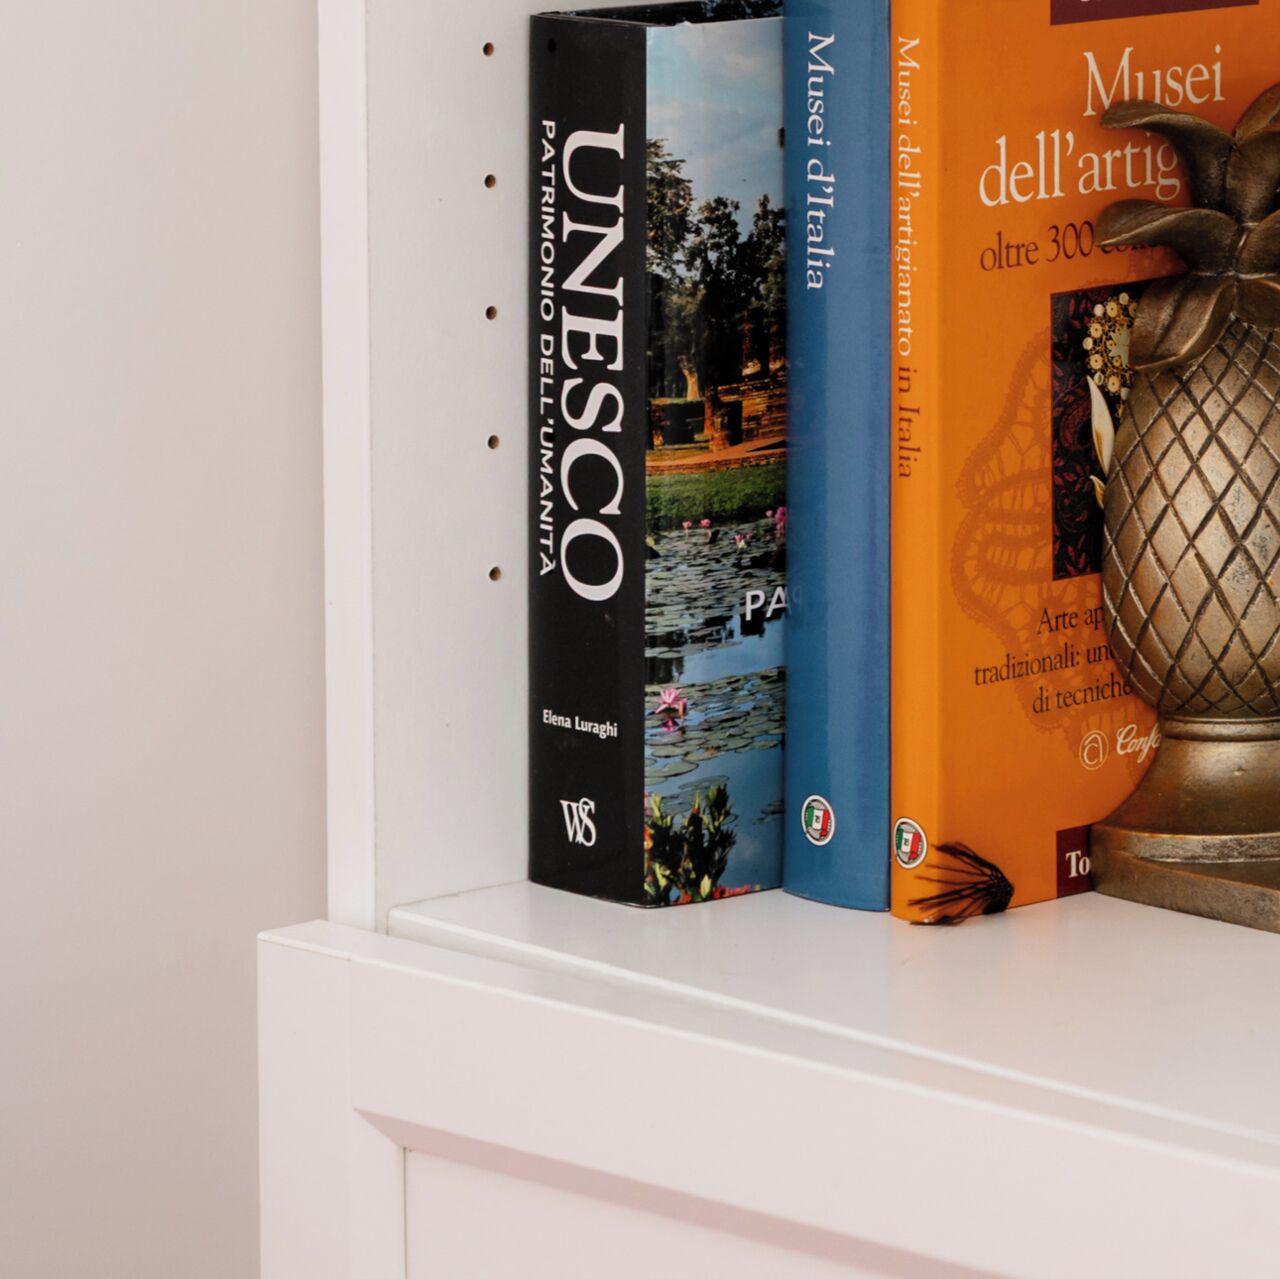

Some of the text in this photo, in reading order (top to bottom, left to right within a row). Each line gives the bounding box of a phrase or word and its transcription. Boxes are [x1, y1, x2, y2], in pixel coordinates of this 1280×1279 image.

[1082, 43, 1226, 118] Musei
[807, 32, 836, 291] Musei d'Italia
[539, 120, 556, 322] PATRIMONIO
[979, 219, 1095, 272] oltre 300
[895, 37, 922, 478] Musei dell'artigianato in Italia
[560, 123, 625, 602] UNESCO
[1036, 607, 1079, 636] Arte
[974, 642, 1080, 686] tradizionali:
[542, 709, 618, 740] Elena Luraghi
[1032, 685, 1050, 714] di
